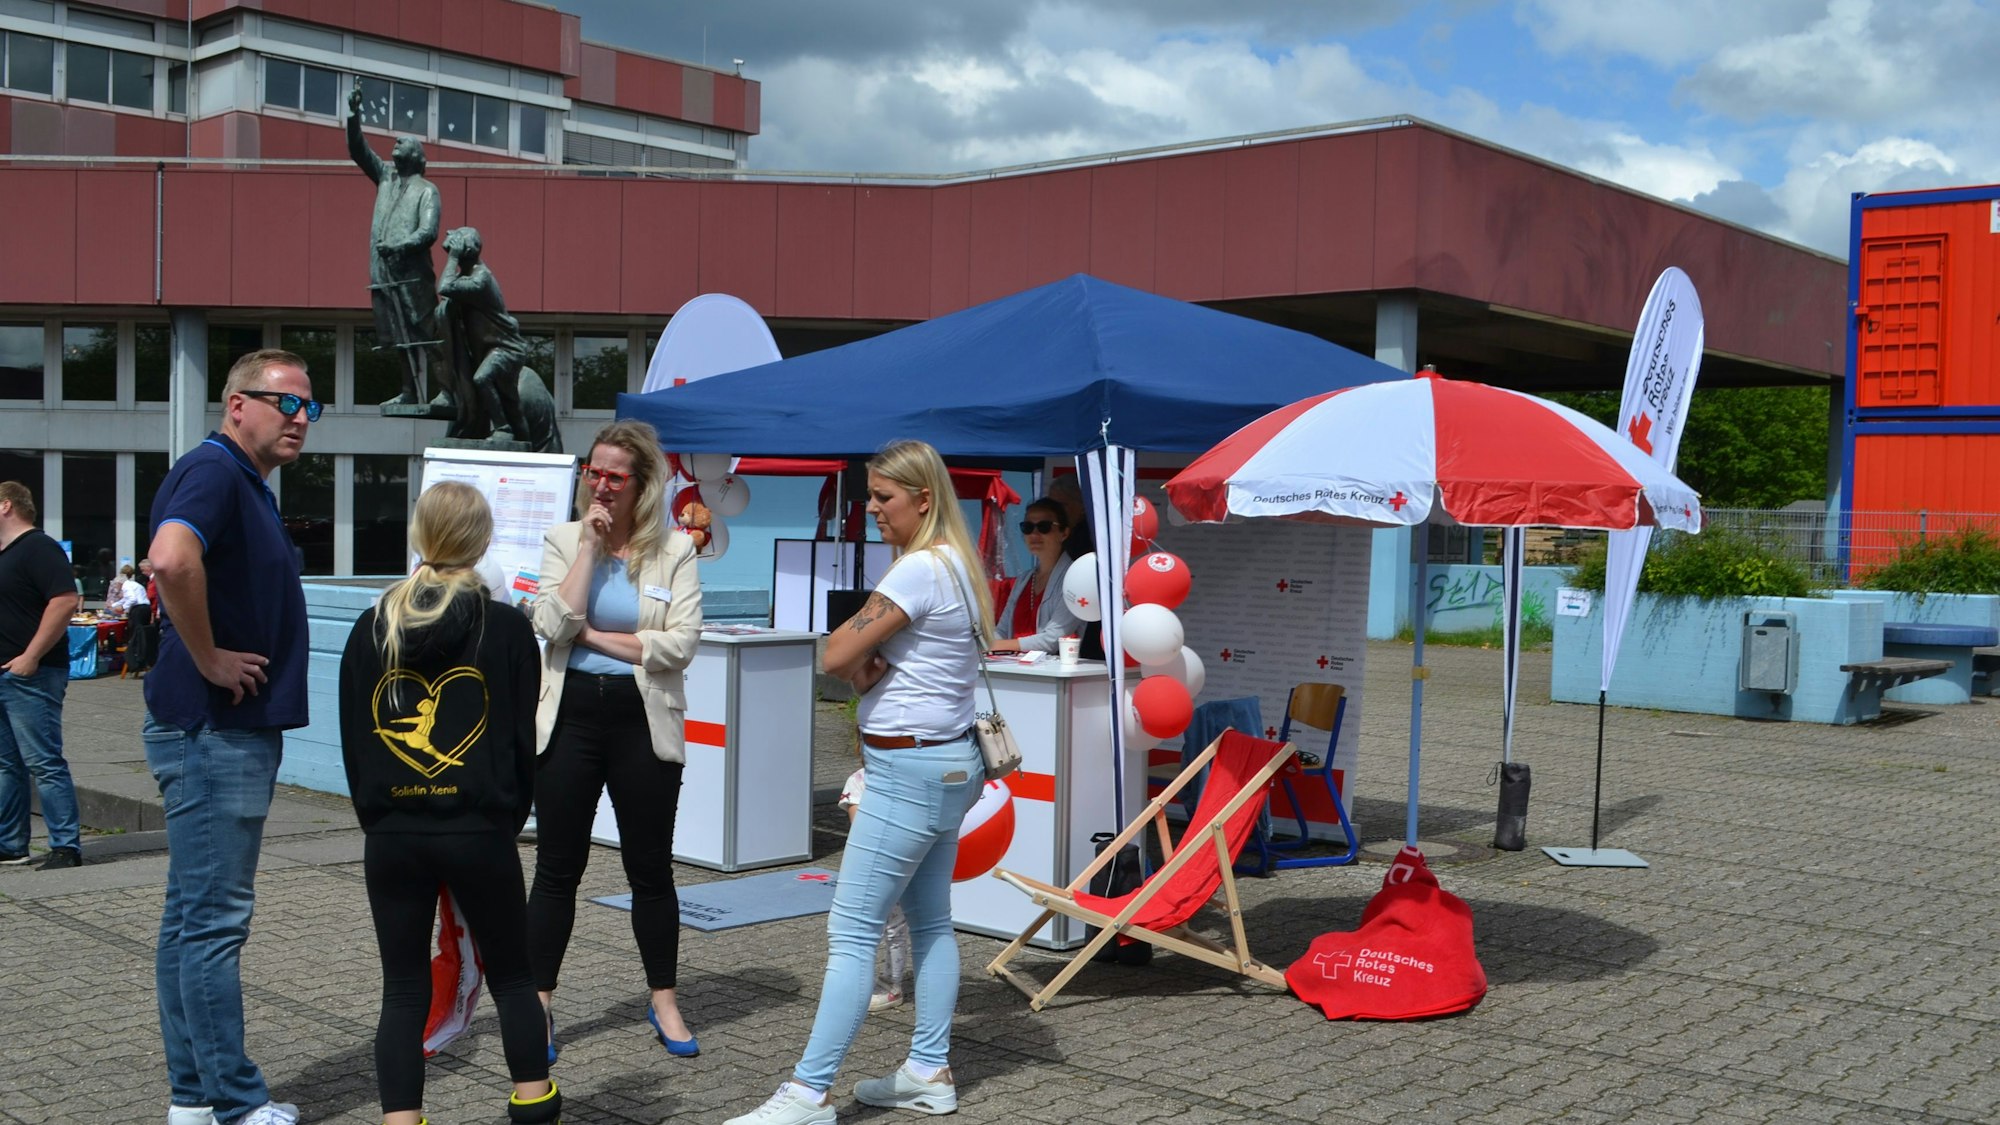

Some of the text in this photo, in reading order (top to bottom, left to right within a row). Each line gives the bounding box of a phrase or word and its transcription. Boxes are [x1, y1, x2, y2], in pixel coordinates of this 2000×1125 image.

[1252, 489, 1384, 504] Deutsches Rotes Kreuz
[391, 784, 458, 797] Solistin Xenia
[1355, 957, 1396, 974] Rotes
[1359, 948, 1434, 973] Deutsches
[1353, 969, 1392, 987] Kreuz
